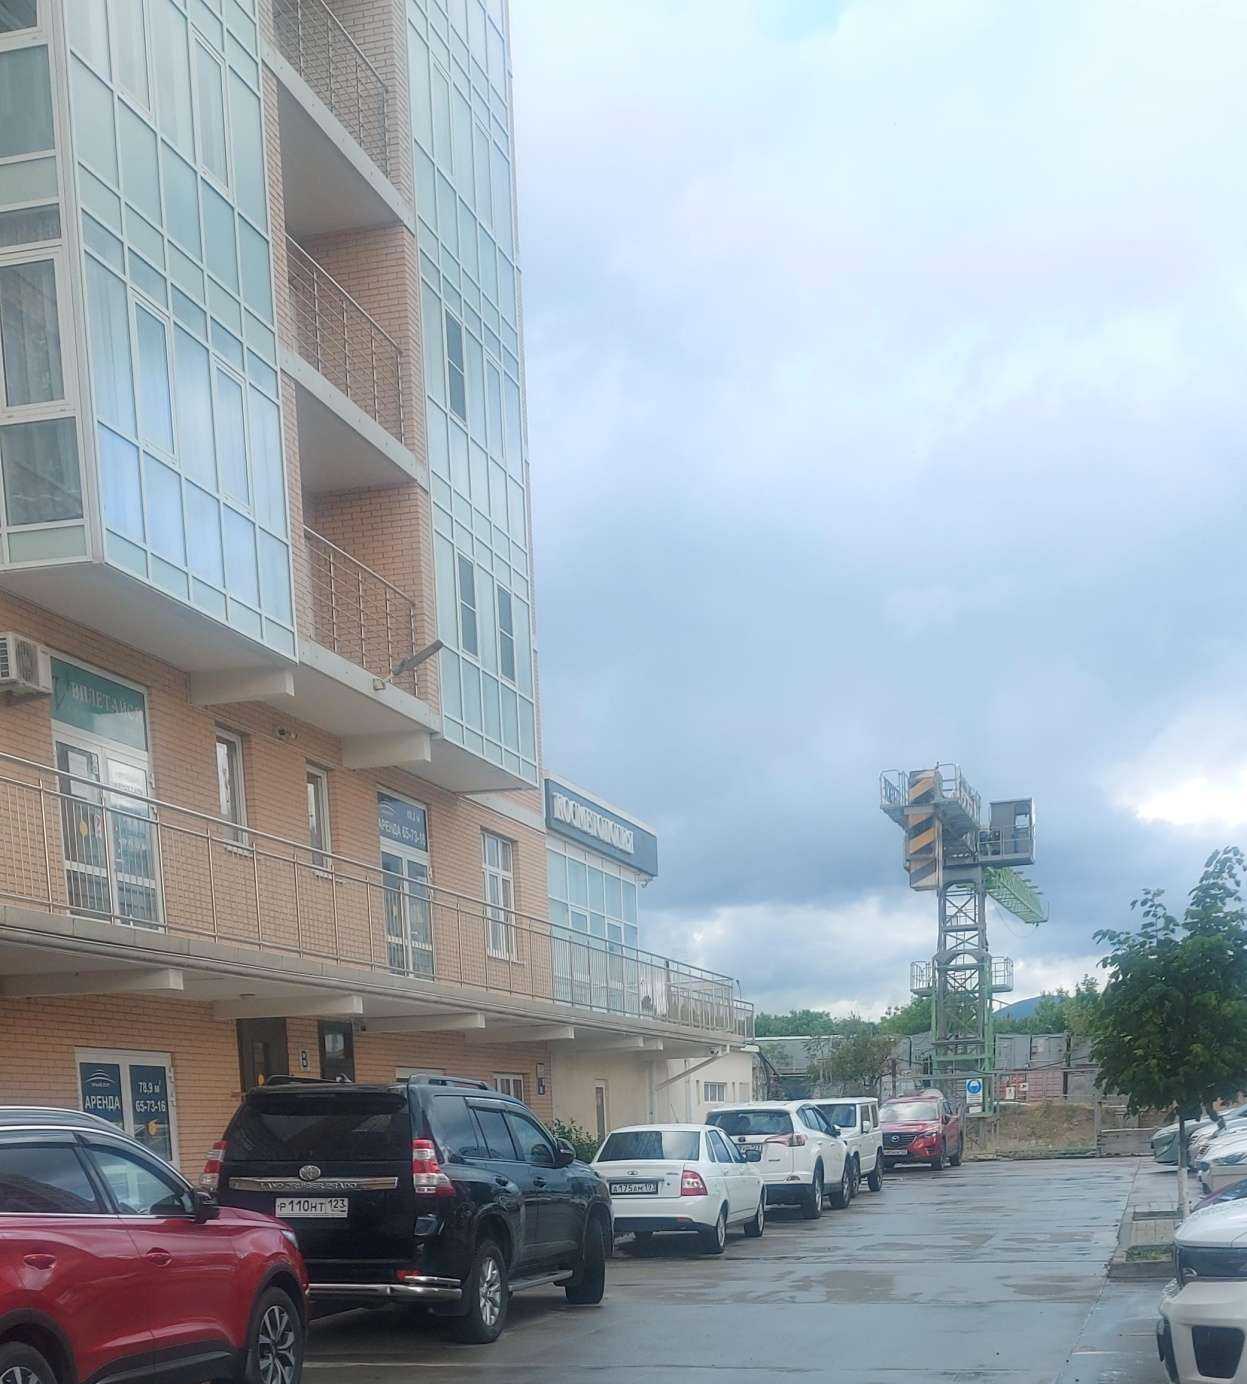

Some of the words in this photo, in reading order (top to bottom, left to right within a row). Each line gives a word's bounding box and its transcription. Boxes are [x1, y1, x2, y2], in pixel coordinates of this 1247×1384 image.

[85, 1096, 121, 1112] АРЕНДА
[135, 1101, 166, 1112] 65-73-16
[328, 1199, 346, 1209] 123
